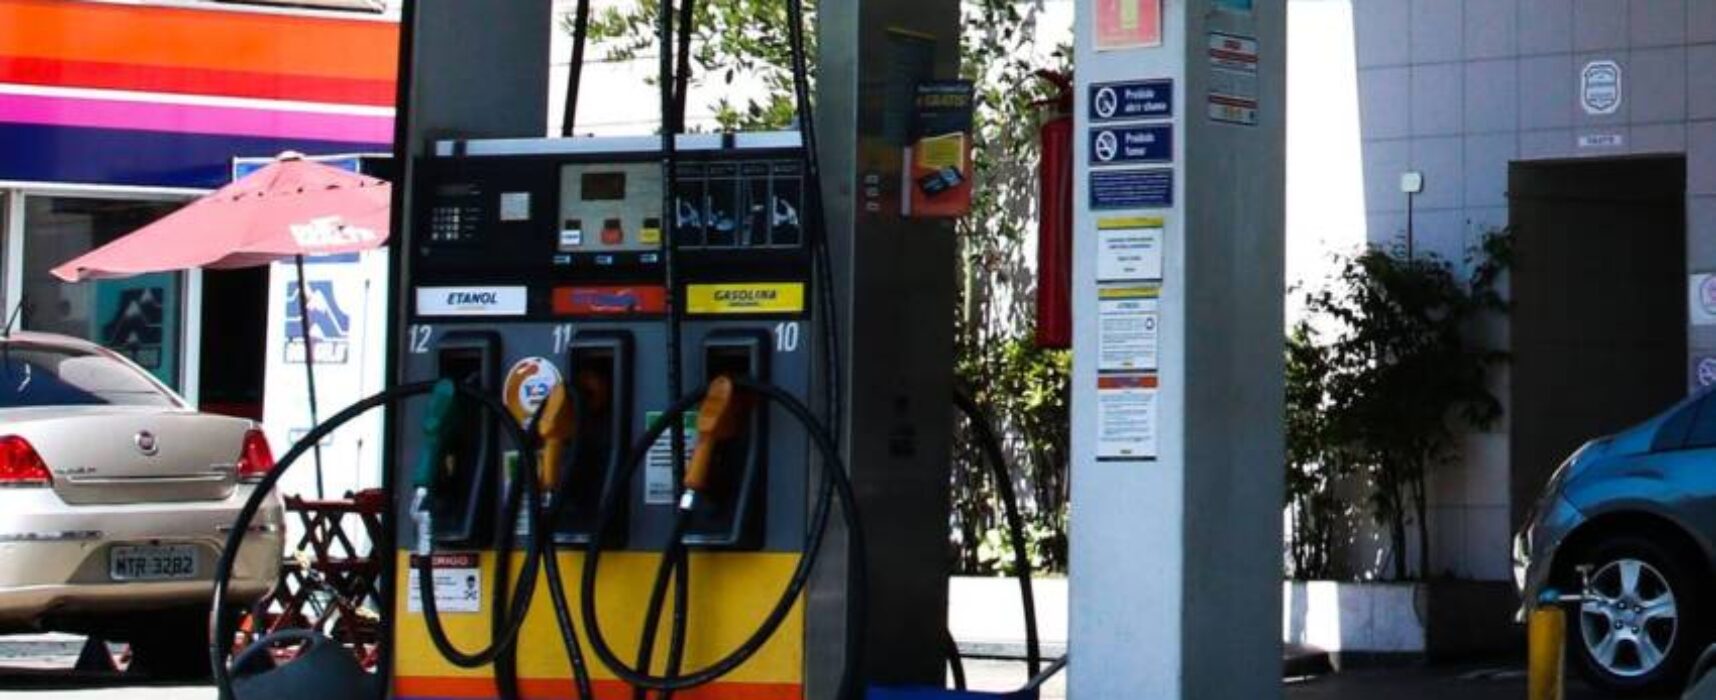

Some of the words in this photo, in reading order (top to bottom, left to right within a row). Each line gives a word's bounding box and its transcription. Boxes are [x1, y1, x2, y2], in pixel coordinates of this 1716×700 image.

[447, 292, 498, 305] ETANOL
[714, 289, 777, 301] GASOLINA
[409, 324, 432, 353] 12
[553, 323, 572, 354] 11
[774, 322, 799, 352] 10
[431, 555, 469, 566] ERIGO
